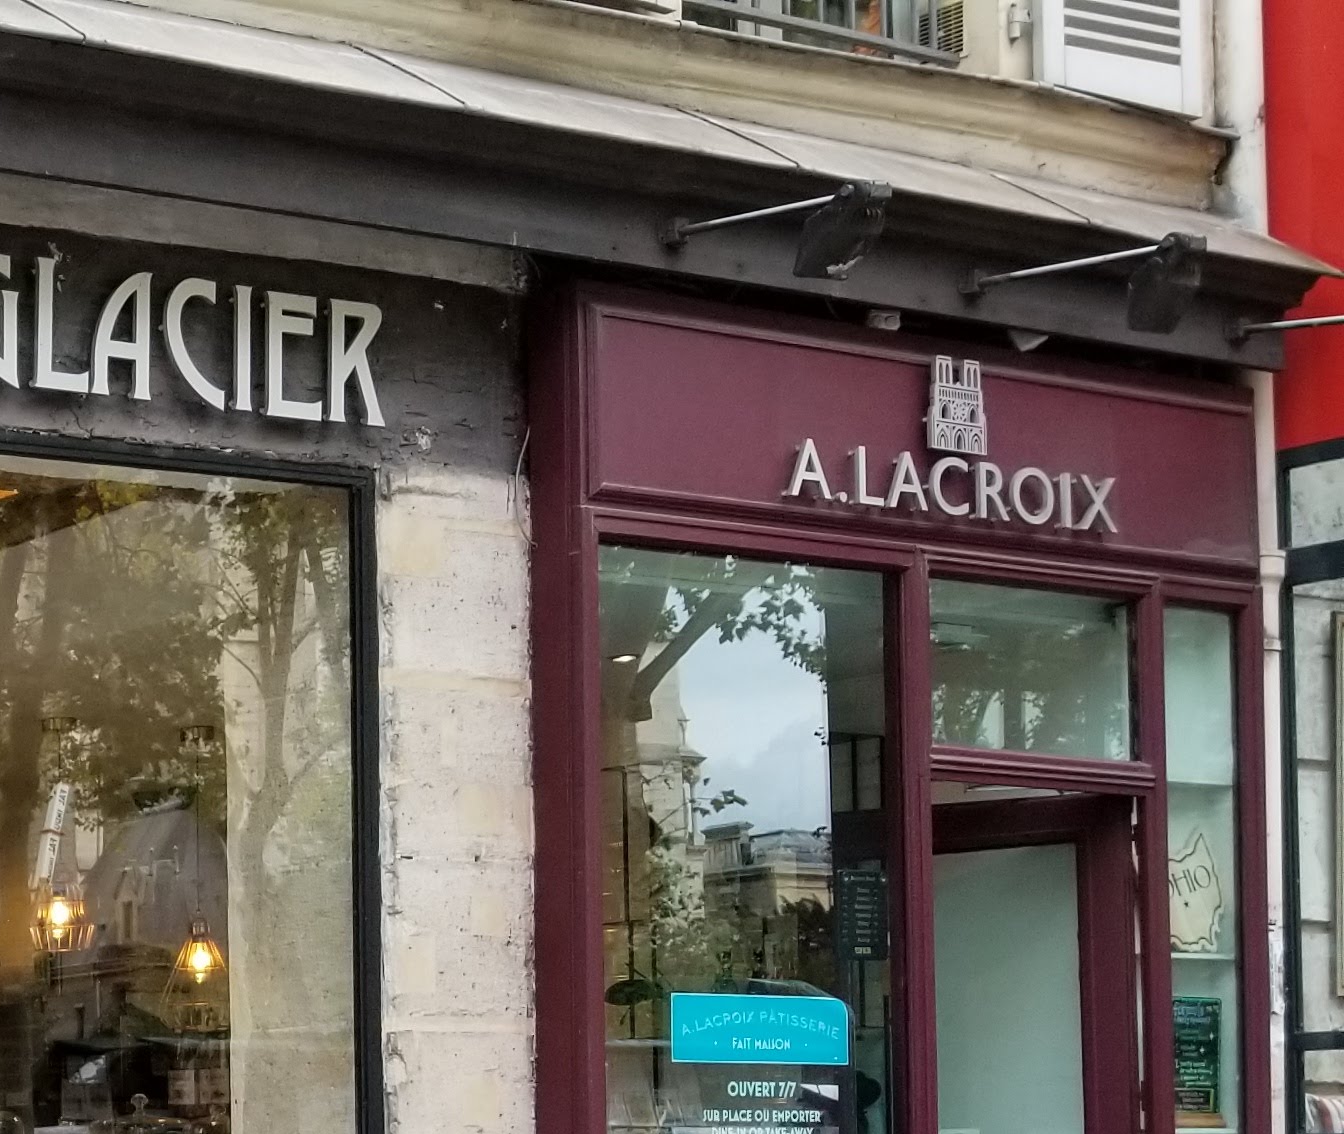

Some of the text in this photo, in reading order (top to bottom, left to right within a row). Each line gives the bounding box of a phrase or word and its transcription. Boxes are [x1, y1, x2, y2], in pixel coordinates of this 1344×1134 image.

[1169, 865, 1210, 898] HIO
[732, 1037, 790, 1050] FAIT MAISON
[727, 1081, 796, 1098] OUVERT 7/7
[703, 1109, 821, 1122] SUR PLACE OU EMPORTER
